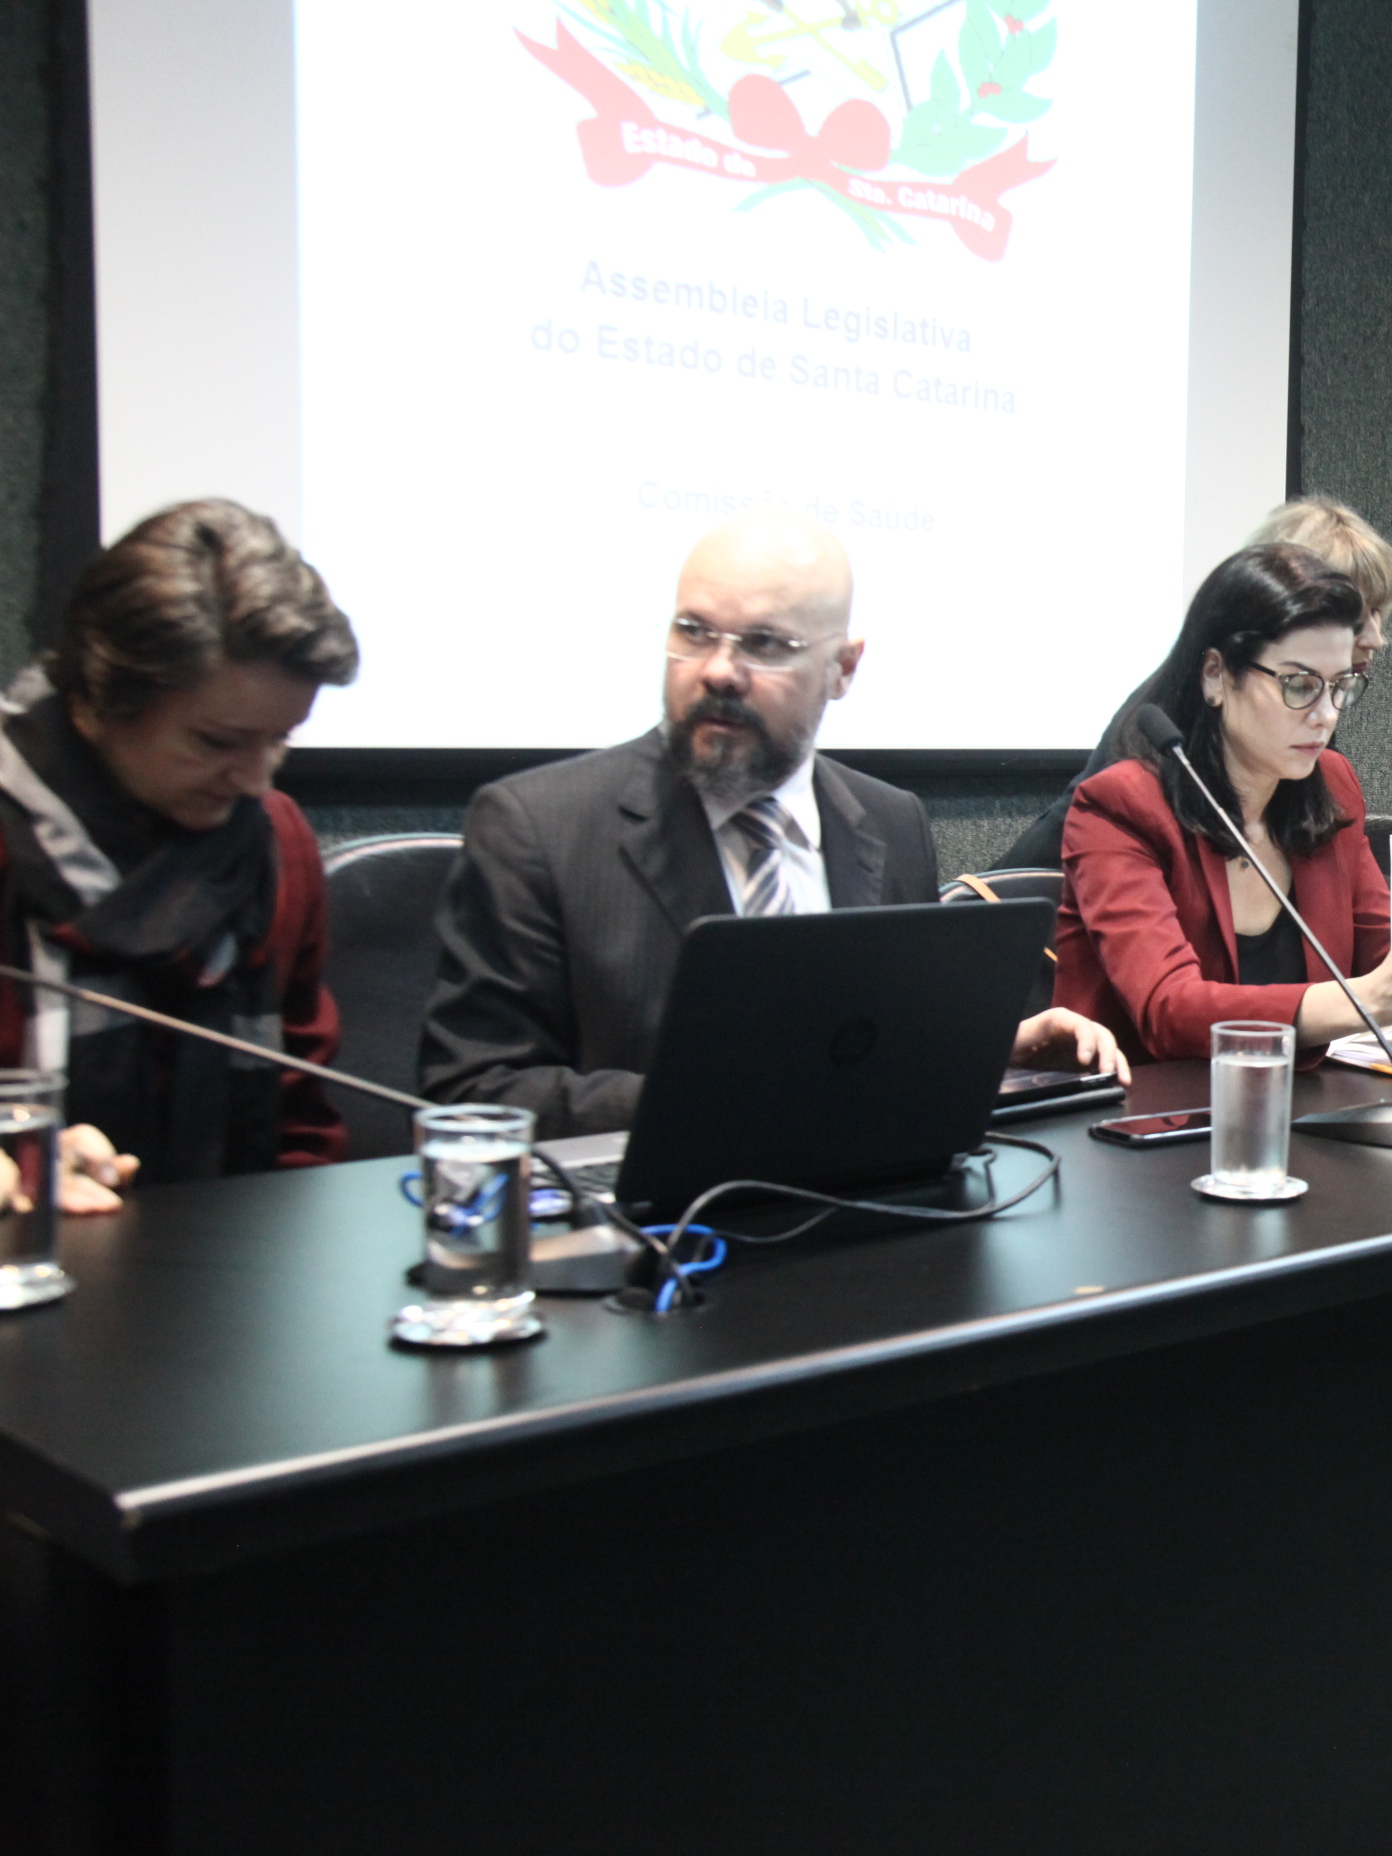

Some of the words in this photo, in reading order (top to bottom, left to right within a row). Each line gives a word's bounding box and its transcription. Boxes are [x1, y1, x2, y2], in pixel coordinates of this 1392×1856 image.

[621, 120, 718, 170] Estado
[723, 152, 757, 178] de
[848, 177, 892, 206] Sta.
[897, 186, 996, 233] Catarina
[580, 259, 789, 325] Assembleia
[802, 296, 972, 353] Legislativa
[530, 318, 581, 355] do
[596, 324, 723, 374] Estado
[736, 346, 777, 381] de
[789, 353, 880, 396] Santa
[892, 369, 1017, 415] Catarina
